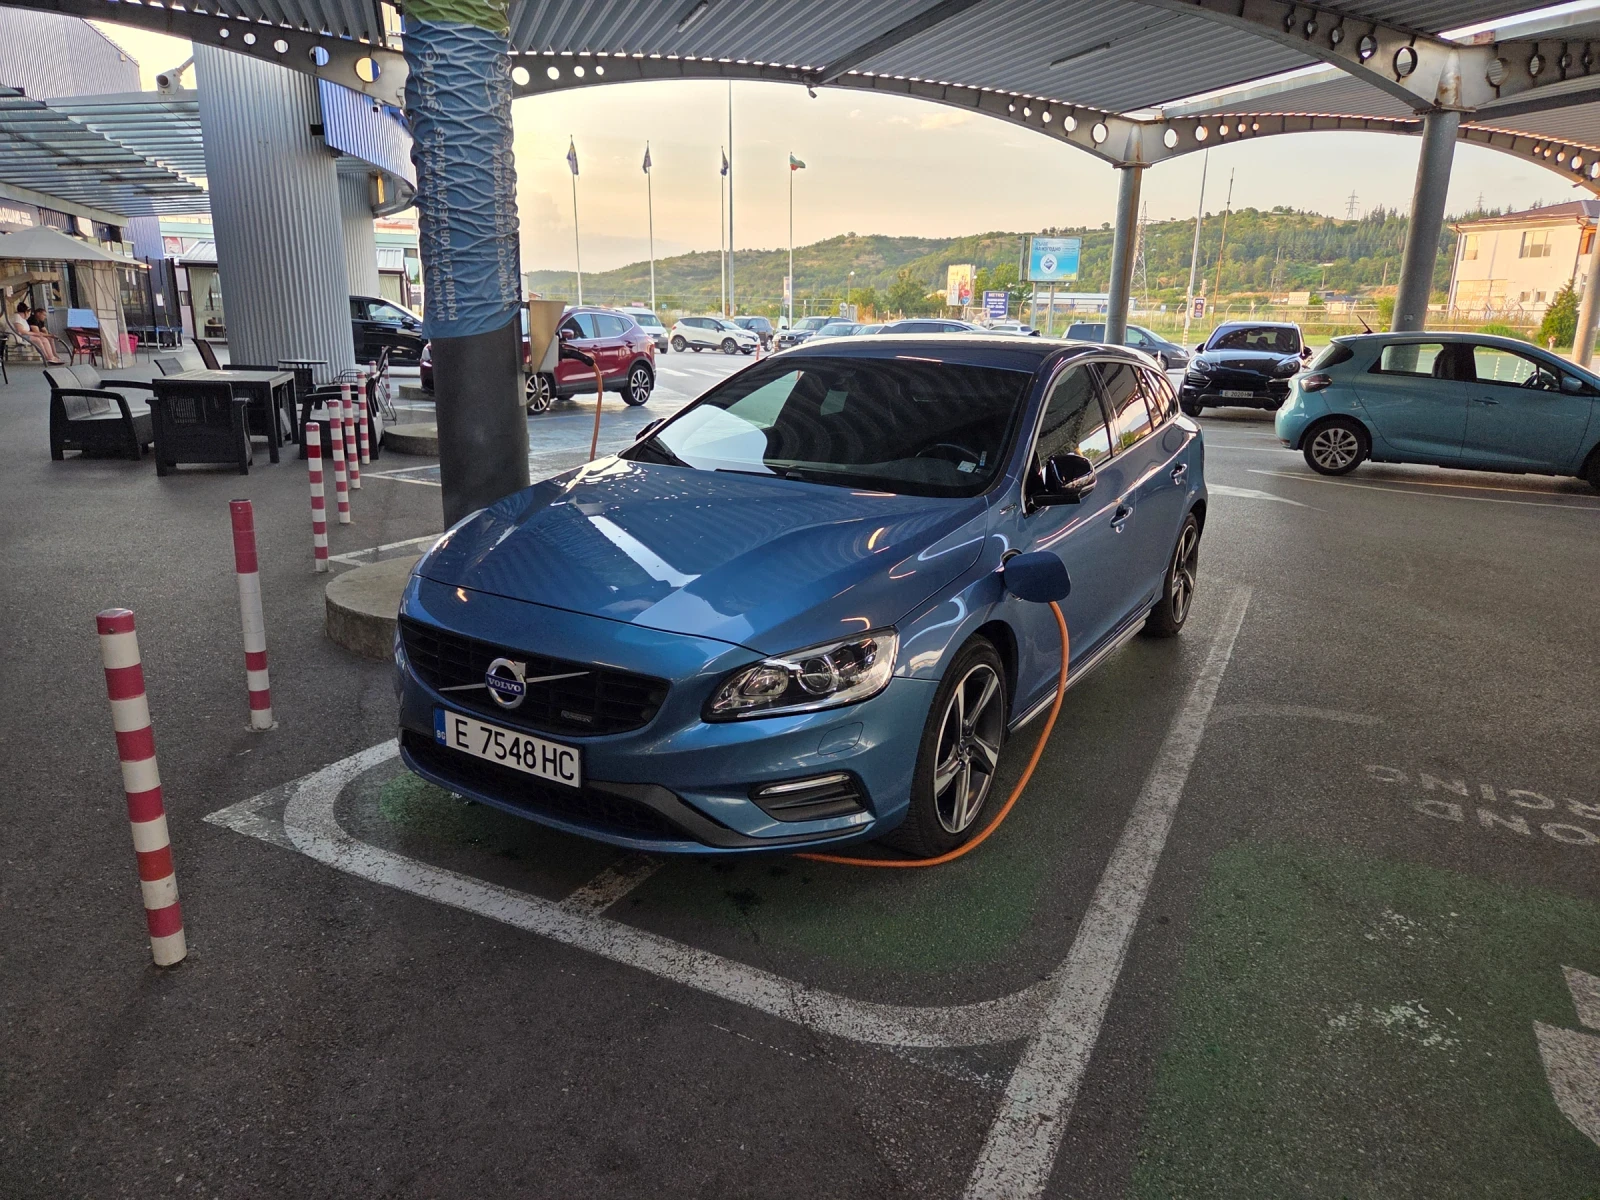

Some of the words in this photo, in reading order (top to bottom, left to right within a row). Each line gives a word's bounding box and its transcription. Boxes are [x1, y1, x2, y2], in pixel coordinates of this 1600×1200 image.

[443, 274, 459, 321] PARKING
[488, 677, 521, 692] VOLVO
[436, 730, 446, 740] BG
[455, 718, 469, 749] E
[480, 726, 537, 769] 7548
[541, 744, 575, 780] HC
